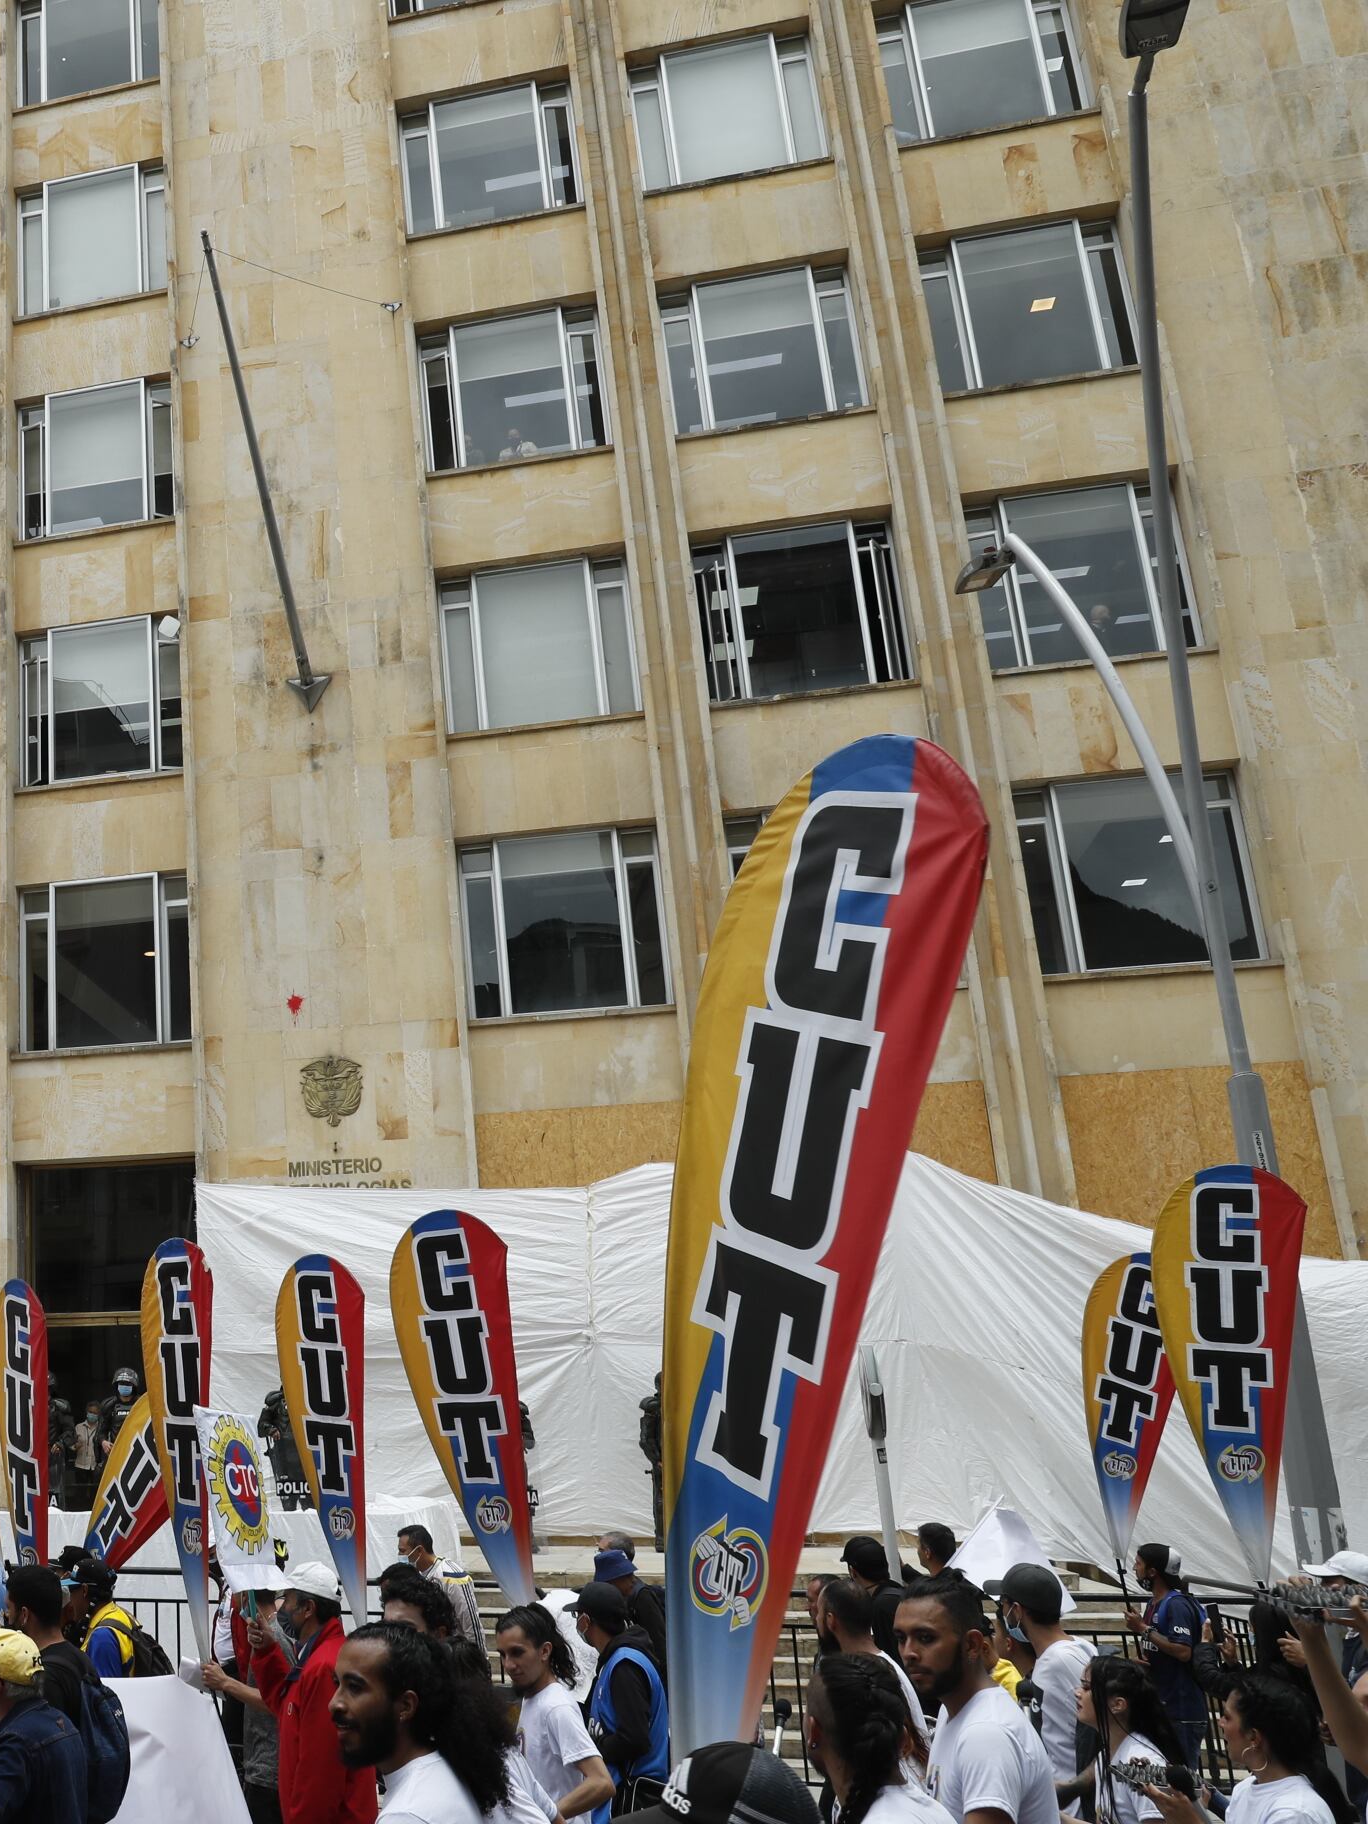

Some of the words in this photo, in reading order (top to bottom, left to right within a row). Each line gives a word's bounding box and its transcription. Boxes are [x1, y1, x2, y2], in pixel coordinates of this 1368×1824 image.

[288, 1157, 382, 1178] MINISTERIO
[690, 790, 918, 1502] CUT
[156, 1256, 201, 1506] CUT
[294, 1270, 357, 1498] CUT
[412, 1227, 508, 1484] CUT
[1094, 1262, 1165, 1448] CUT
[1183, 1181, 1274, 1434] CUT
[4, 1294, 41, 1536] CUT
[95, 1417, 161, 1551] UT
[224, 1462, 259, 1498] CTC
[276, 1481, 311, 1494] POLIC
[1173, 1625, 1191, 1636] QNB
[661, 1786, 692, 1814] das
